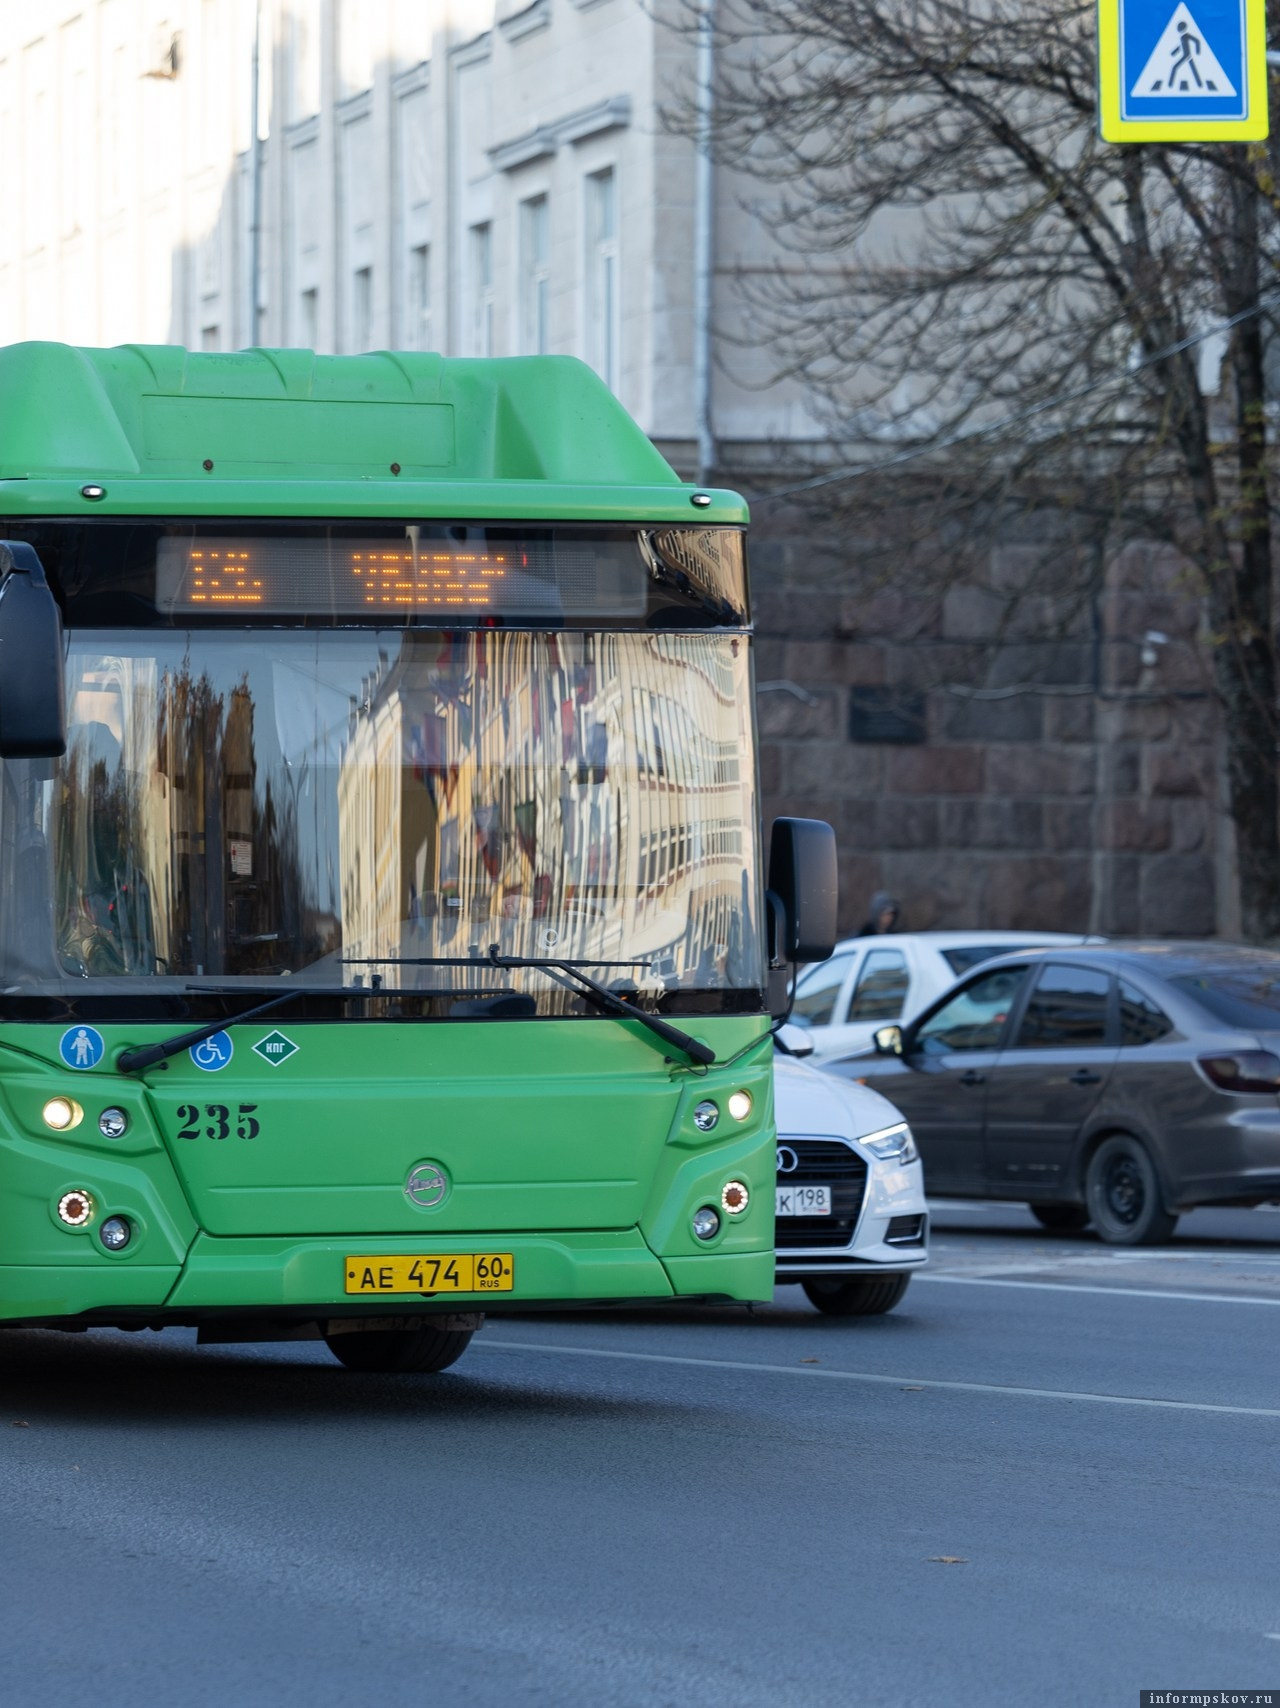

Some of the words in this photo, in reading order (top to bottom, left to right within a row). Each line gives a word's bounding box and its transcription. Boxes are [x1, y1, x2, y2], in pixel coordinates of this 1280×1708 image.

[266, 1043, 285, 1053] КПГ
[176, 1103, 260, 1140] 235
[796, 1189, 825, 1206] 198
[360, 1267, 393, 1288] АЕ
[408, 1260, 459, 1288] 474
[477, 1257, 503, 1278] 60
[480, 1280, 500, 1288] RUS
